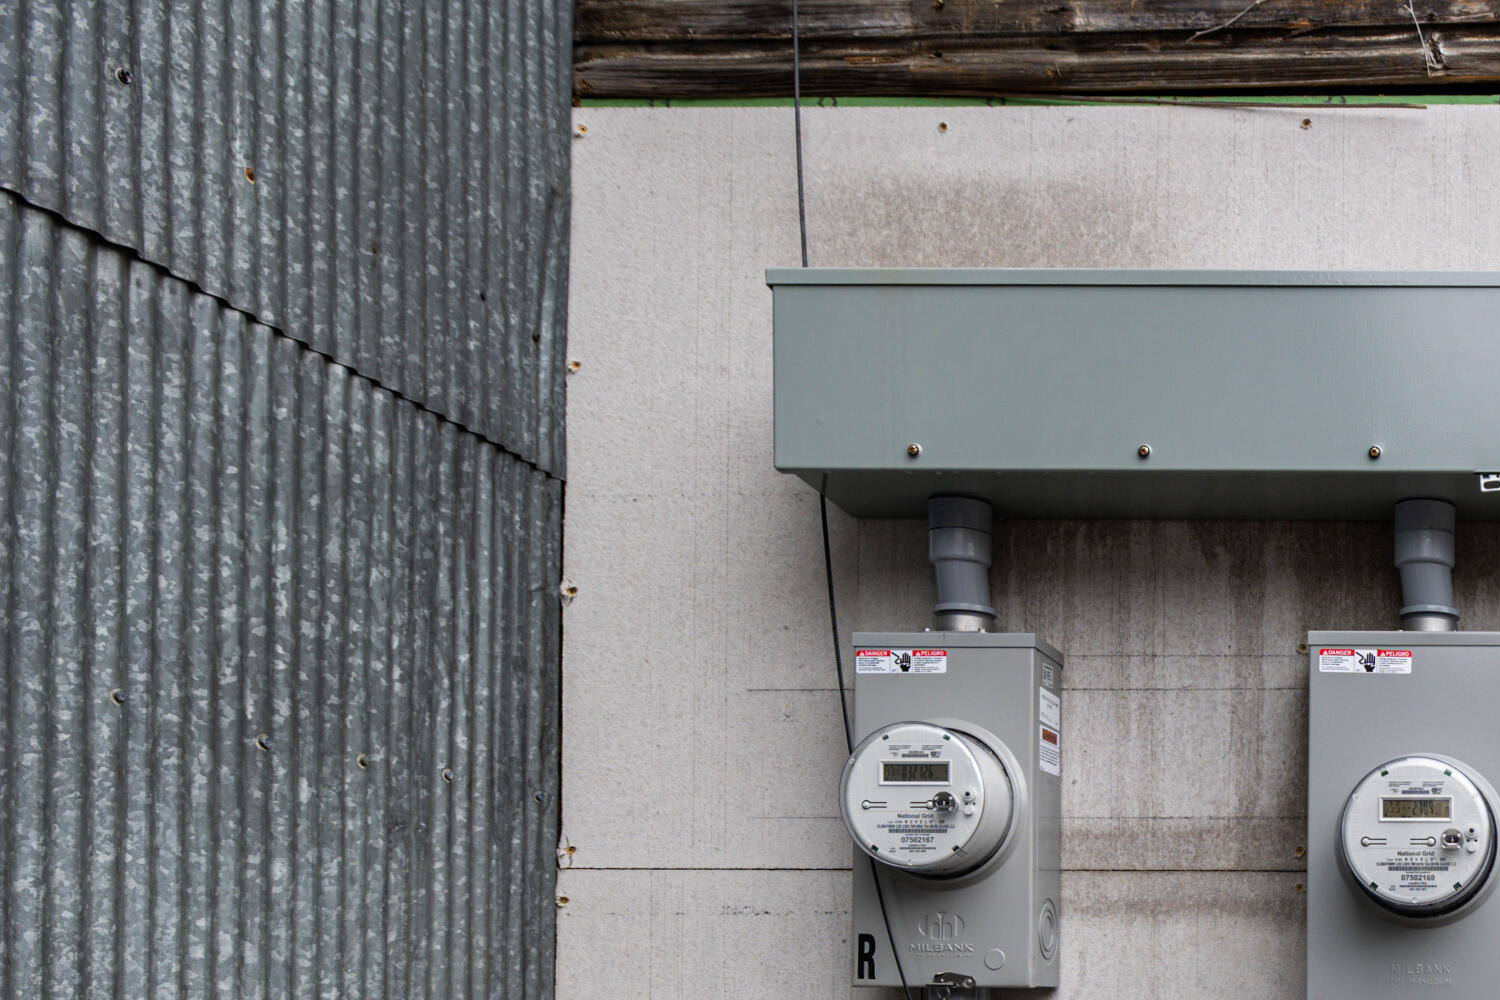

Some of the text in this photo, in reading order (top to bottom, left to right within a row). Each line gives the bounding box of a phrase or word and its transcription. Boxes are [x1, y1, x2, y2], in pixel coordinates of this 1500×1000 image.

[909, 943, 975, 953] MILBANK
[858, 933, 875, 979] R
[1391, 963, 1452, 975] MILBANK
